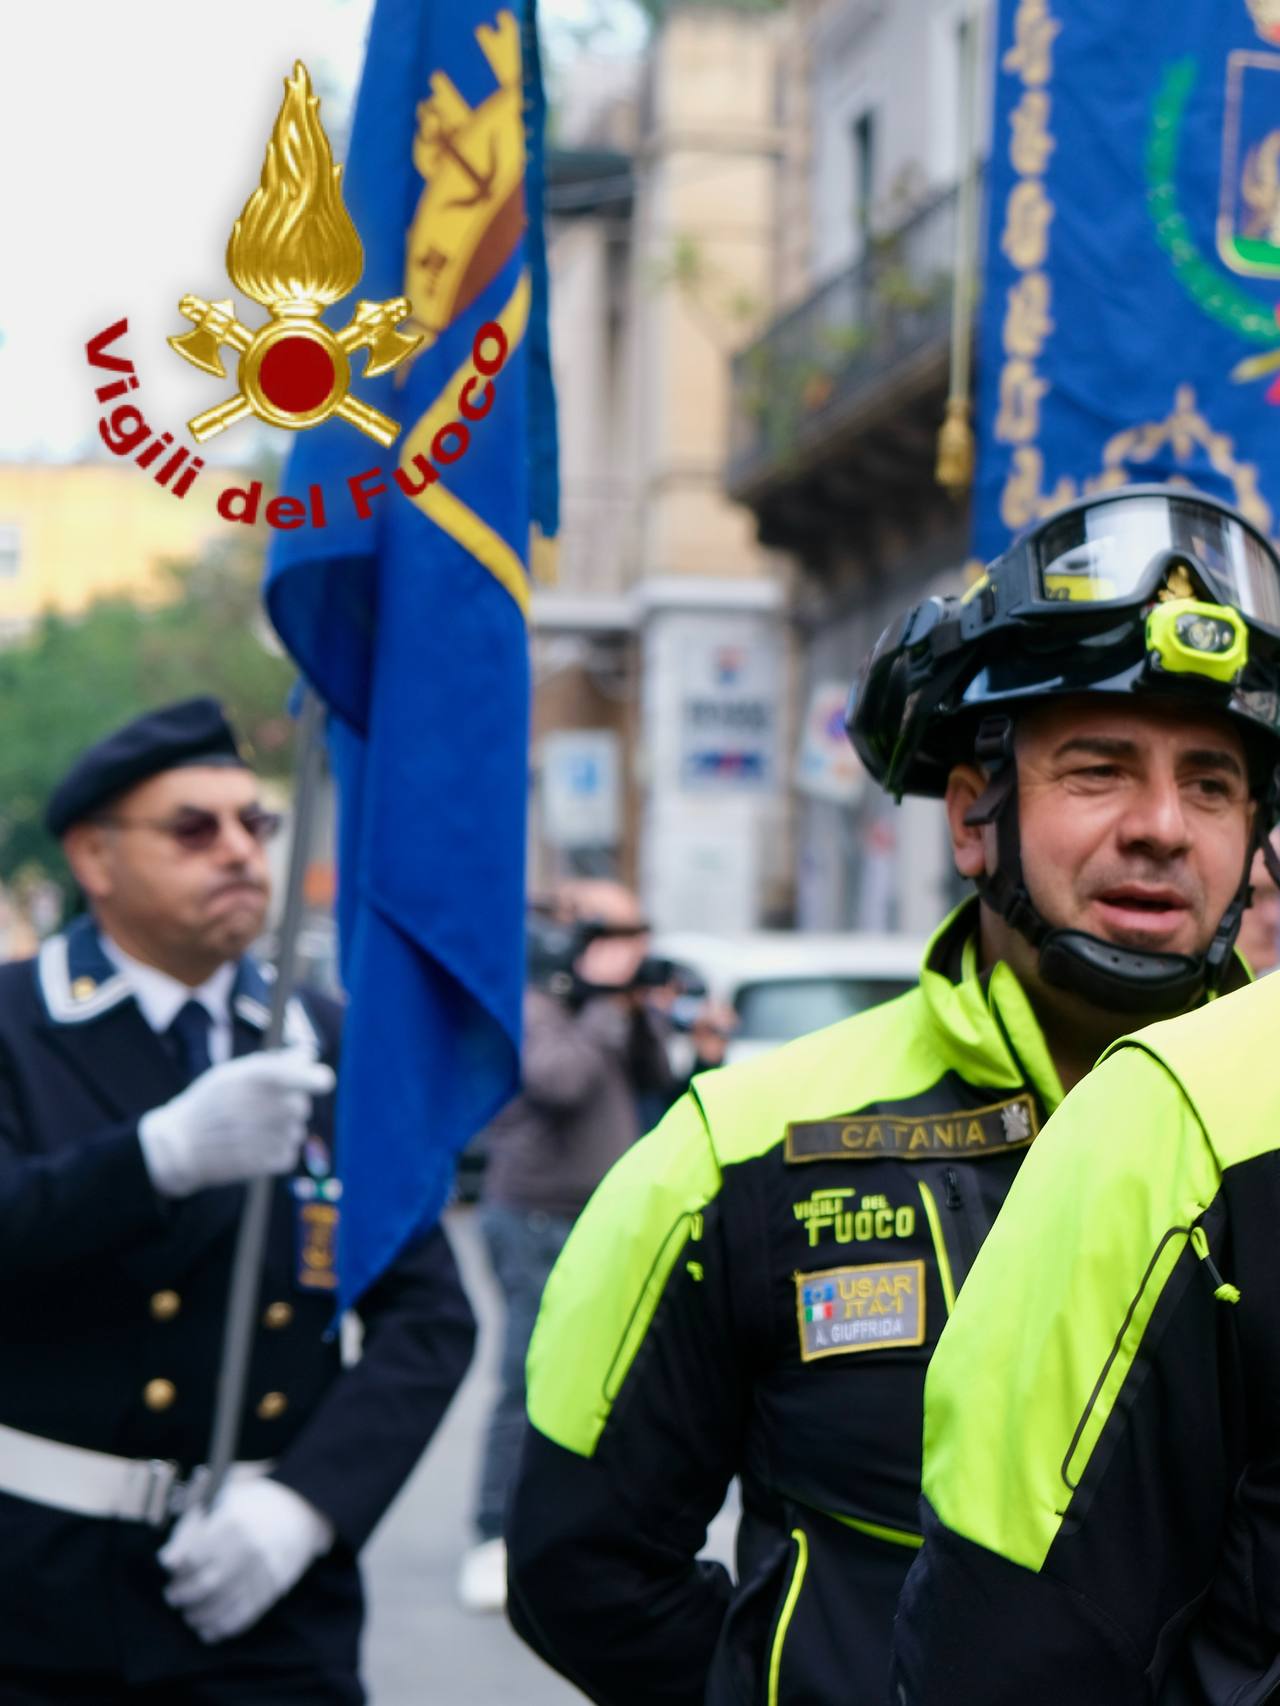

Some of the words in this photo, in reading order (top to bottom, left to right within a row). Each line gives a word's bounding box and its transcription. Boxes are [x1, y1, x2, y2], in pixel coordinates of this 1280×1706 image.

[841, 1121, 987, 1152] CATANIA
[793, 1195, 846, 1220] VIGILI
[861, 1195, 888, 1211] DEL
[804, 1205, 916, 1248] FUOCO
[836, 1274, 913, 1301] USAR
[842, 1294, 905, 1318] ITA-1
[831, 1317, 903, 1343] GIUFFRIDA
